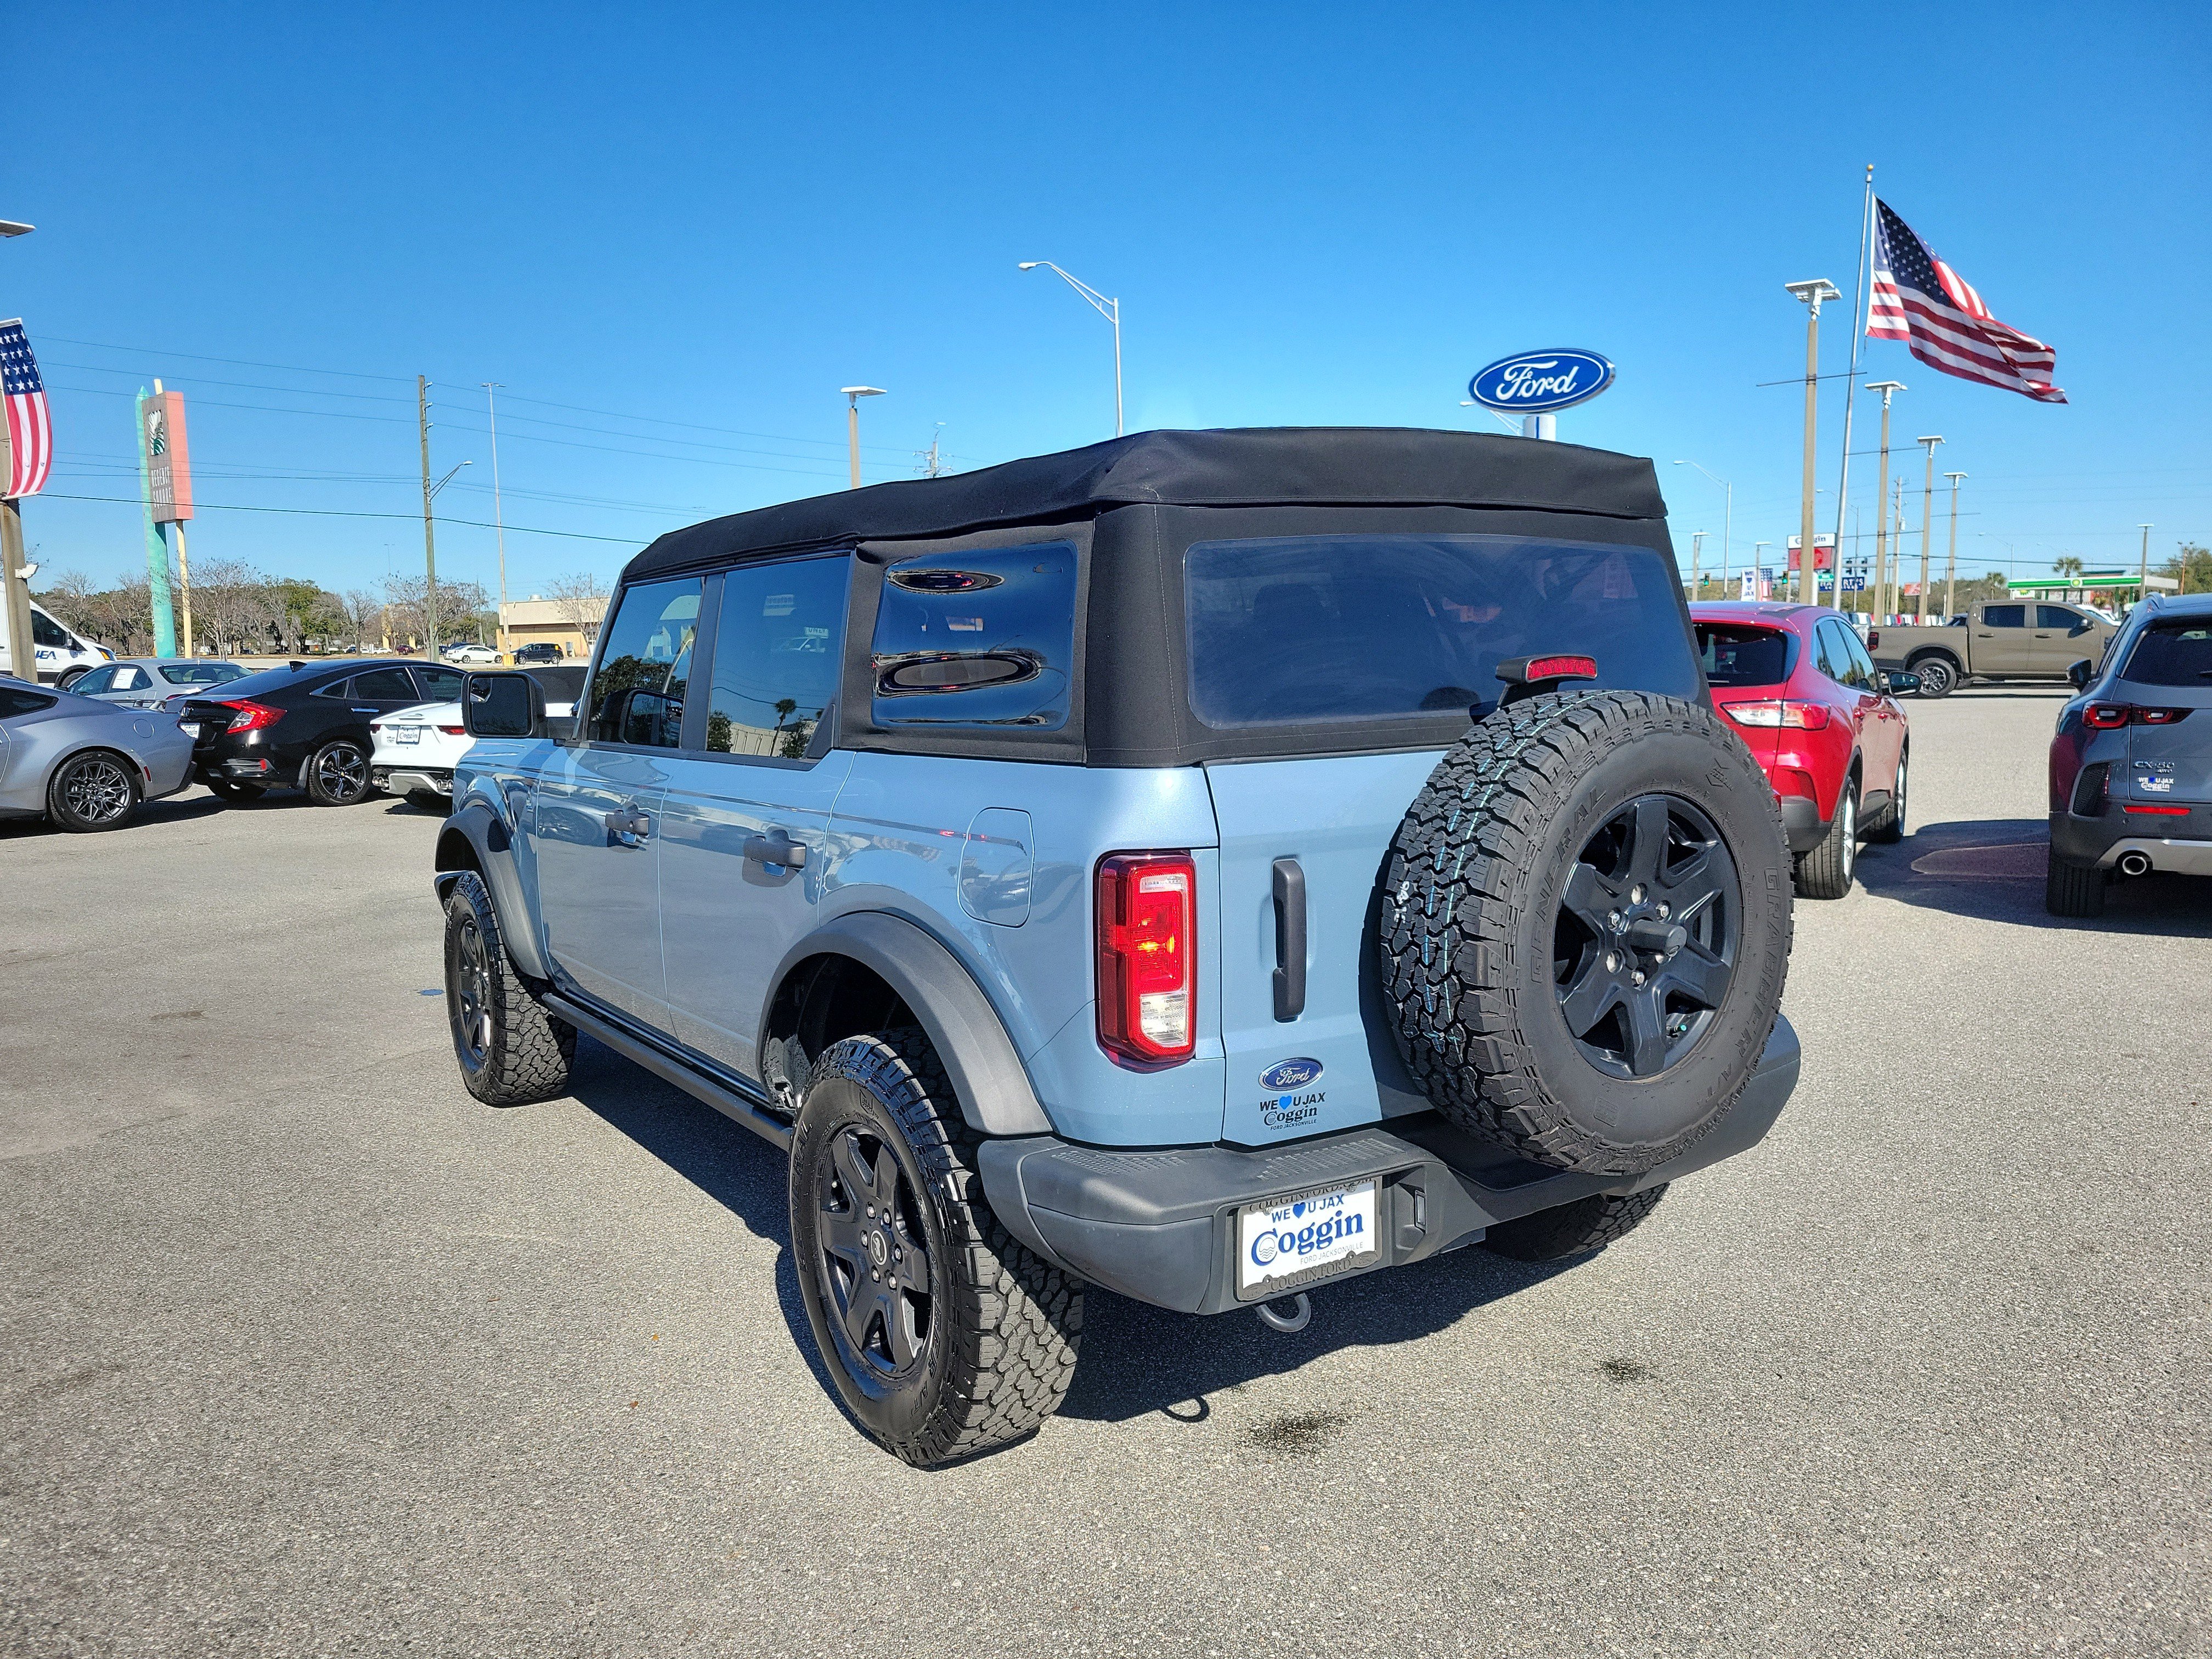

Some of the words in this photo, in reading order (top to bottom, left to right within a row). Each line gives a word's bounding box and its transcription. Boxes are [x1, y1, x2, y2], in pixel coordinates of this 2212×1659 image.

[1496, 360, 1579, 400] Ford
[151, 466, 170, 487] REGENCY
[153, 487, 172, 509] SQUARE
[1795, 535, 1826, 544] Cgin
[1276, 1066, 1311, 1086] Ford
[1260, 1099, 1279, 1112] WE
[1293, 1096, 1301, 1107] U
[1302, 1092, 1326, 1105] JAX
[1263, 1105, 1318, 1126] Coggin
[1283, 1119, 1317, 1129] JACKSONVILLE
[1249, 1177, 1373, 1212] COGGINFORD.
[1272, 1208, 1291, 1223] WE
[1308, 1201, 1317, 1214] U
[1319, 1193, 1345, 1210] JAX
[1251, 1210, 1364, 1266] Coggin
[1300, 1255, 1318, 1265] FORD
[1318, 1242, 1364, 1260] JACKSONVILLE
[1271, 1269, 1318, 1291] COGGIN
[1321, 1259, 1351, 1277] FORD
